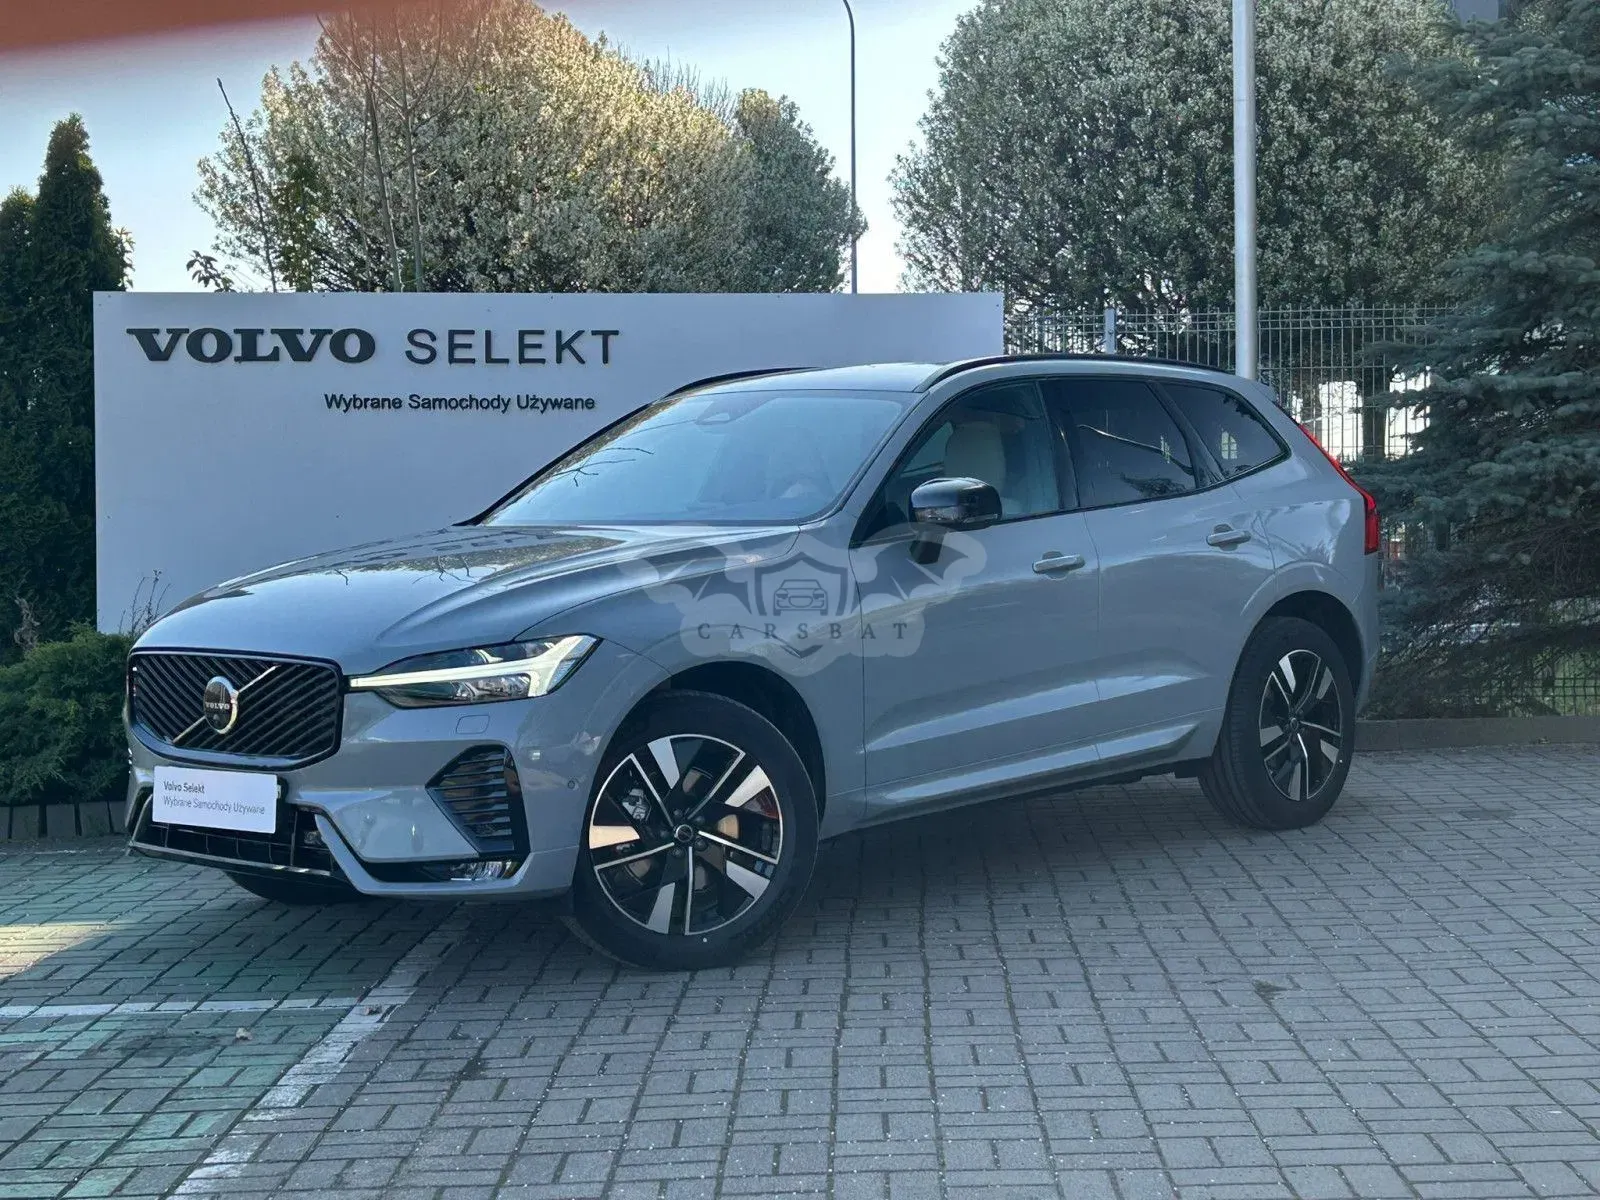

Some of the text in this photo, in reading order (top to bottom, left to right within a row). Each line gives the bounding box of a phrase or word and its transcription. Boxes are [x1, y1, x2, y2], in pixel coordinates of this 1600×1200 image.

[126, 327, 620, 365] VOLVO SELEKT
[324, 393, 596, 414] Wybrane Samochody Używane
[205, 701, 230, 710] VOLVO
[163, 780, 205, 794] Volvo Selekt
[163, 795, 192, 808] Wybrane
[193, 798, 232, 813] Samochody
